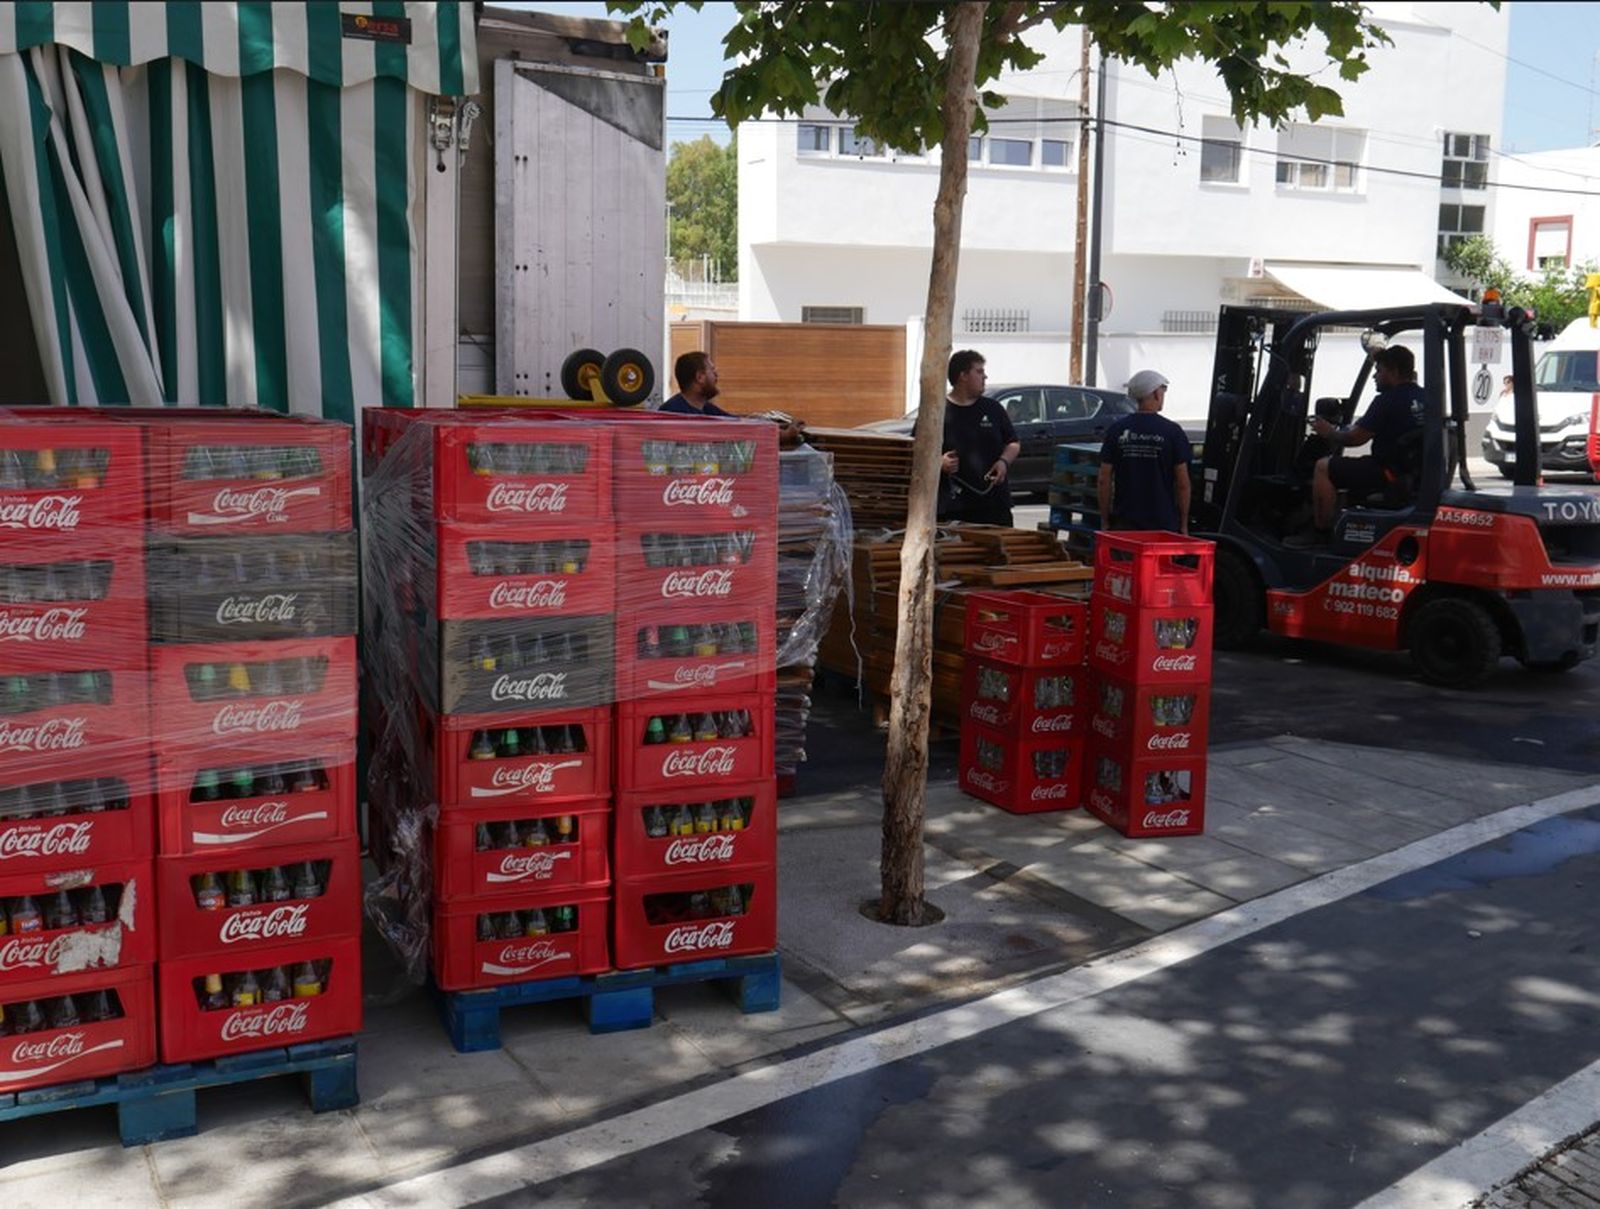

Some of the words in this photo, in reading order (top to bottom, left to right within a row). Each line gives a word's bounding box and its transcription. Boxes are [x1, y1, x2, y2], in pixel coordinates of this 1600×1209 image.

[1475, 373, 1491, 400] 20
[0, 495, 84, 529] ca-Cola
[1328, 581, 1405, 603] mateco
[0, 607, 89, 643] oca-Cola
[1334, 600, 1355, 614] 902
[1357, 603, 1374, 616] 119
[1375, 605, 1399, 620] 682
[0, 717, 88, 751] oca-Cola
